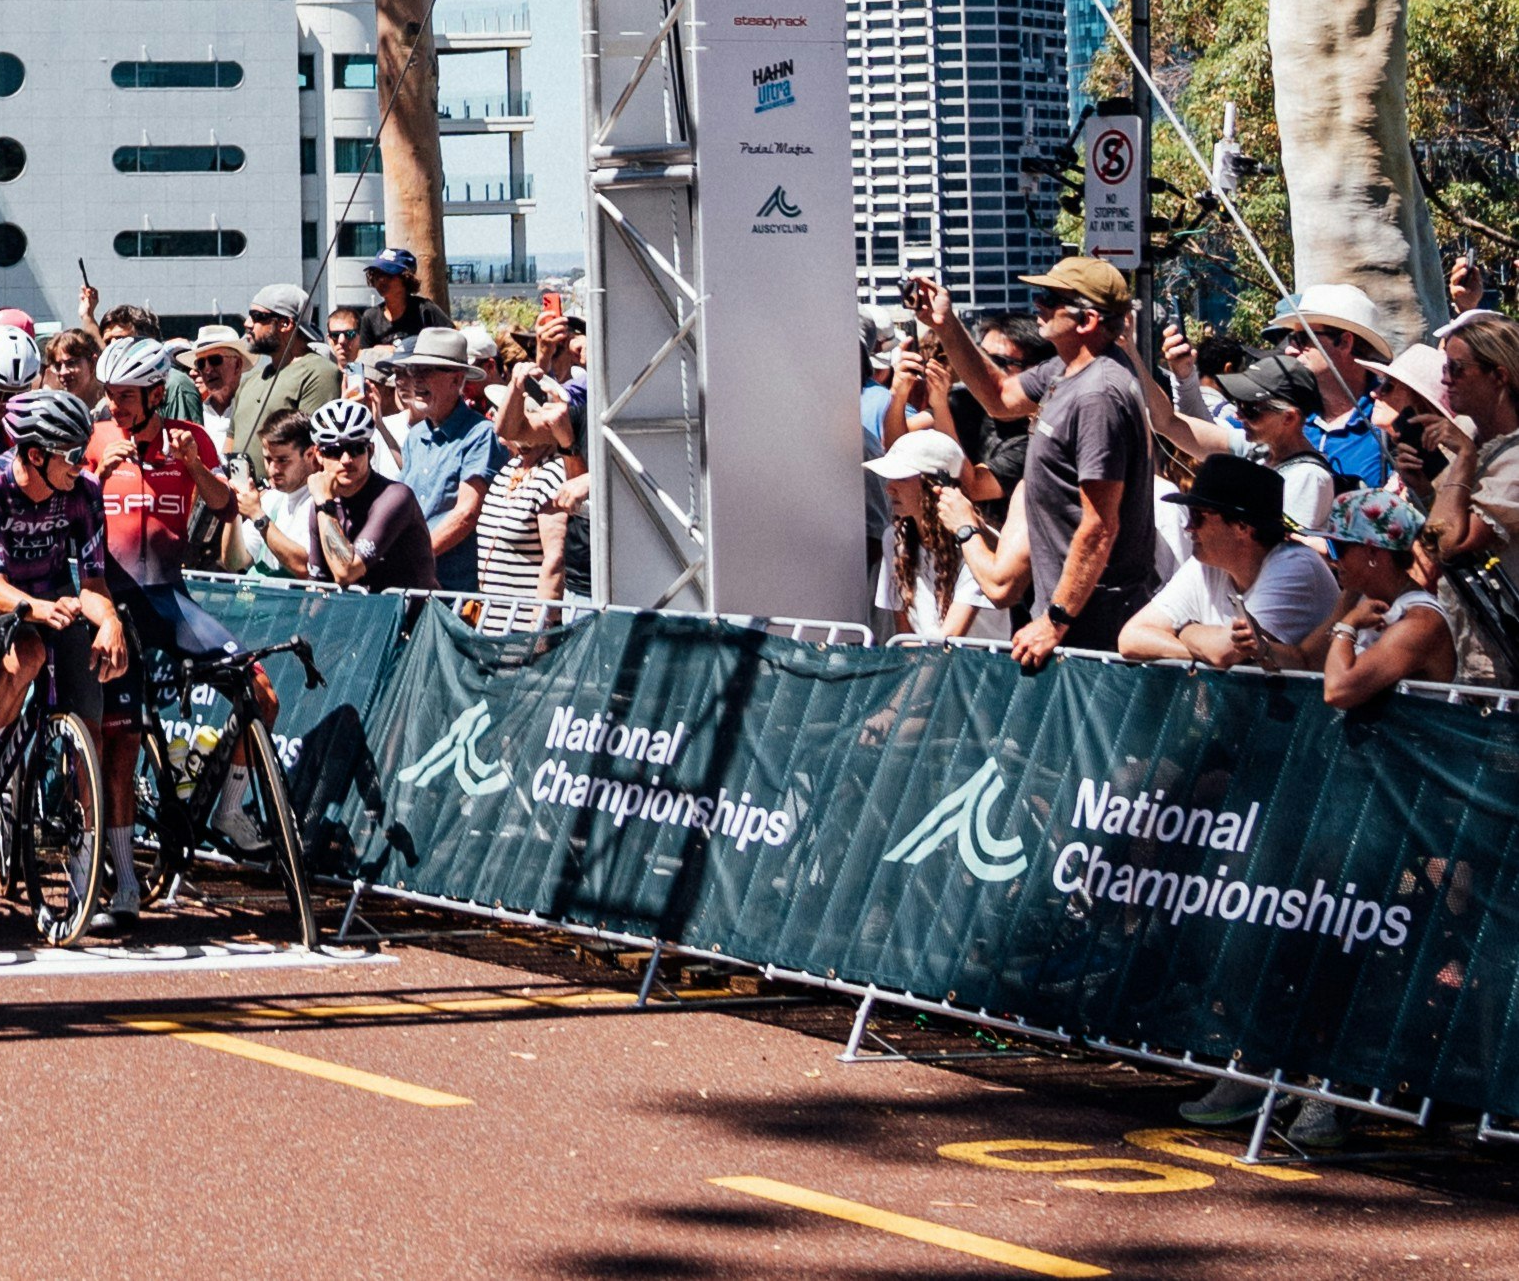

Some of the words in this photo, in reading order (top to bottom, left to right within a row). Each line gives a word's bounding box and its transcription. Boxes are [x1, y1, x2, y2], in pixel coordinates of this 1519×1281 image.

[734, 15, 808, 28] steadyrack
[752, 59, 794, 86] HAHN
[757, 80, 791, 106] Ultra
[1105, 193, 1116, 204] NO
[1094, 207, 1129, 218] STOPPING
[751, 223, 808, 233] AUSCYCLING
[1089, 221, 1097, 231] AT
[1099, 221, 1115, 232] ANY
[1117, 221, 1135, 232] TIME
[0, 517, 70, 535] Jayco
[545, 706, 686, 766] National
[531, 759, 791, 852] Championships
[1070, 778, 1260, 854] National
[1052, 842, 1412, 954] Championships
